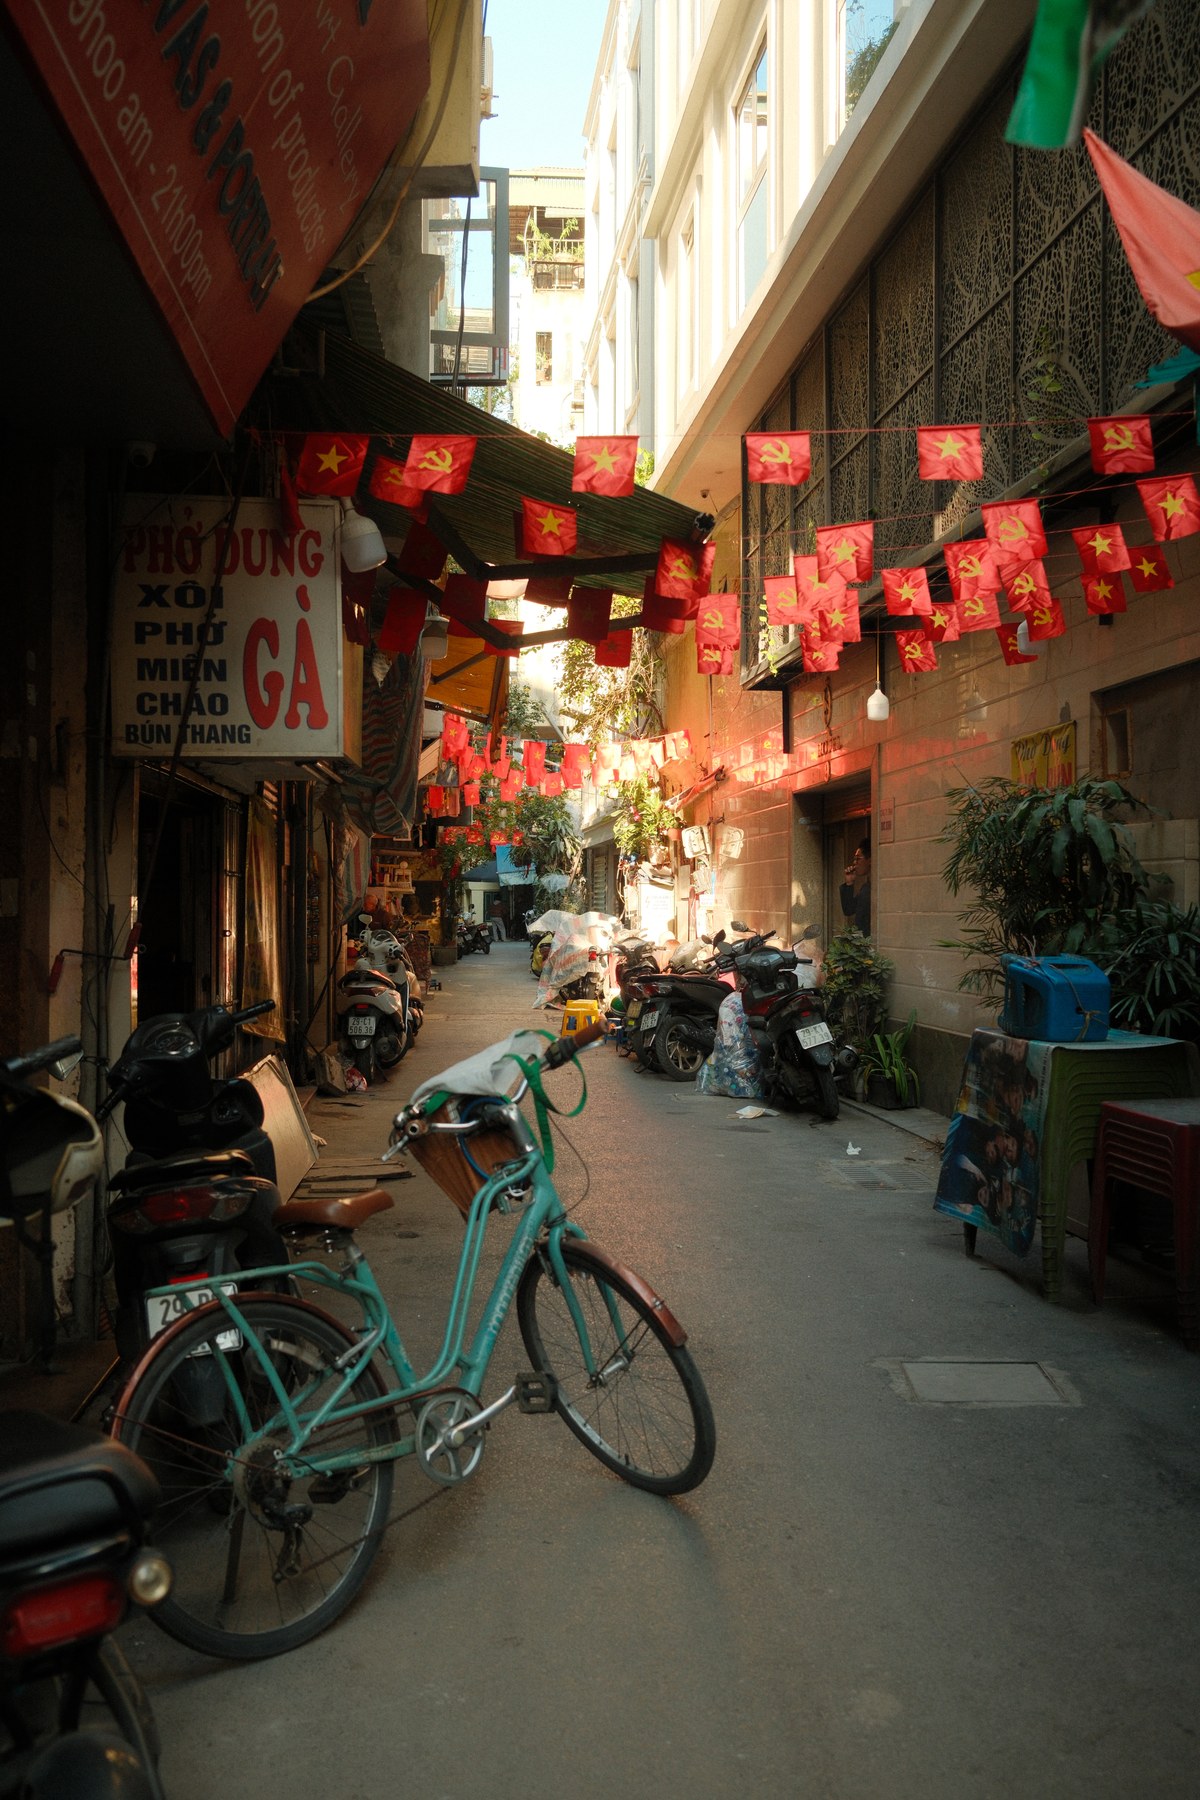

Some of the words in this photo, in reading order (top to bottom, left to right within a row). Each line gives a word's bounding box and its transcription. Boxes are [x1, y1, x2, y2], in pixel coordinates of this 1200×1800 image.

[117, 93, 152, 167] am
[192, 77, 232, 157] &
[268, 69, 304, 119] of
[327, 55, 366, 214] Gallery
[206, 115, 284, 313] PORTRAIT
[213, 526, 324, 577] DUNG
[137, 580, 224, 608] XÔI
[243, 584, 329, 730] GÀ
[125, 719, 171, 744] BÚN
[180, 724, 251, 744] THANG
